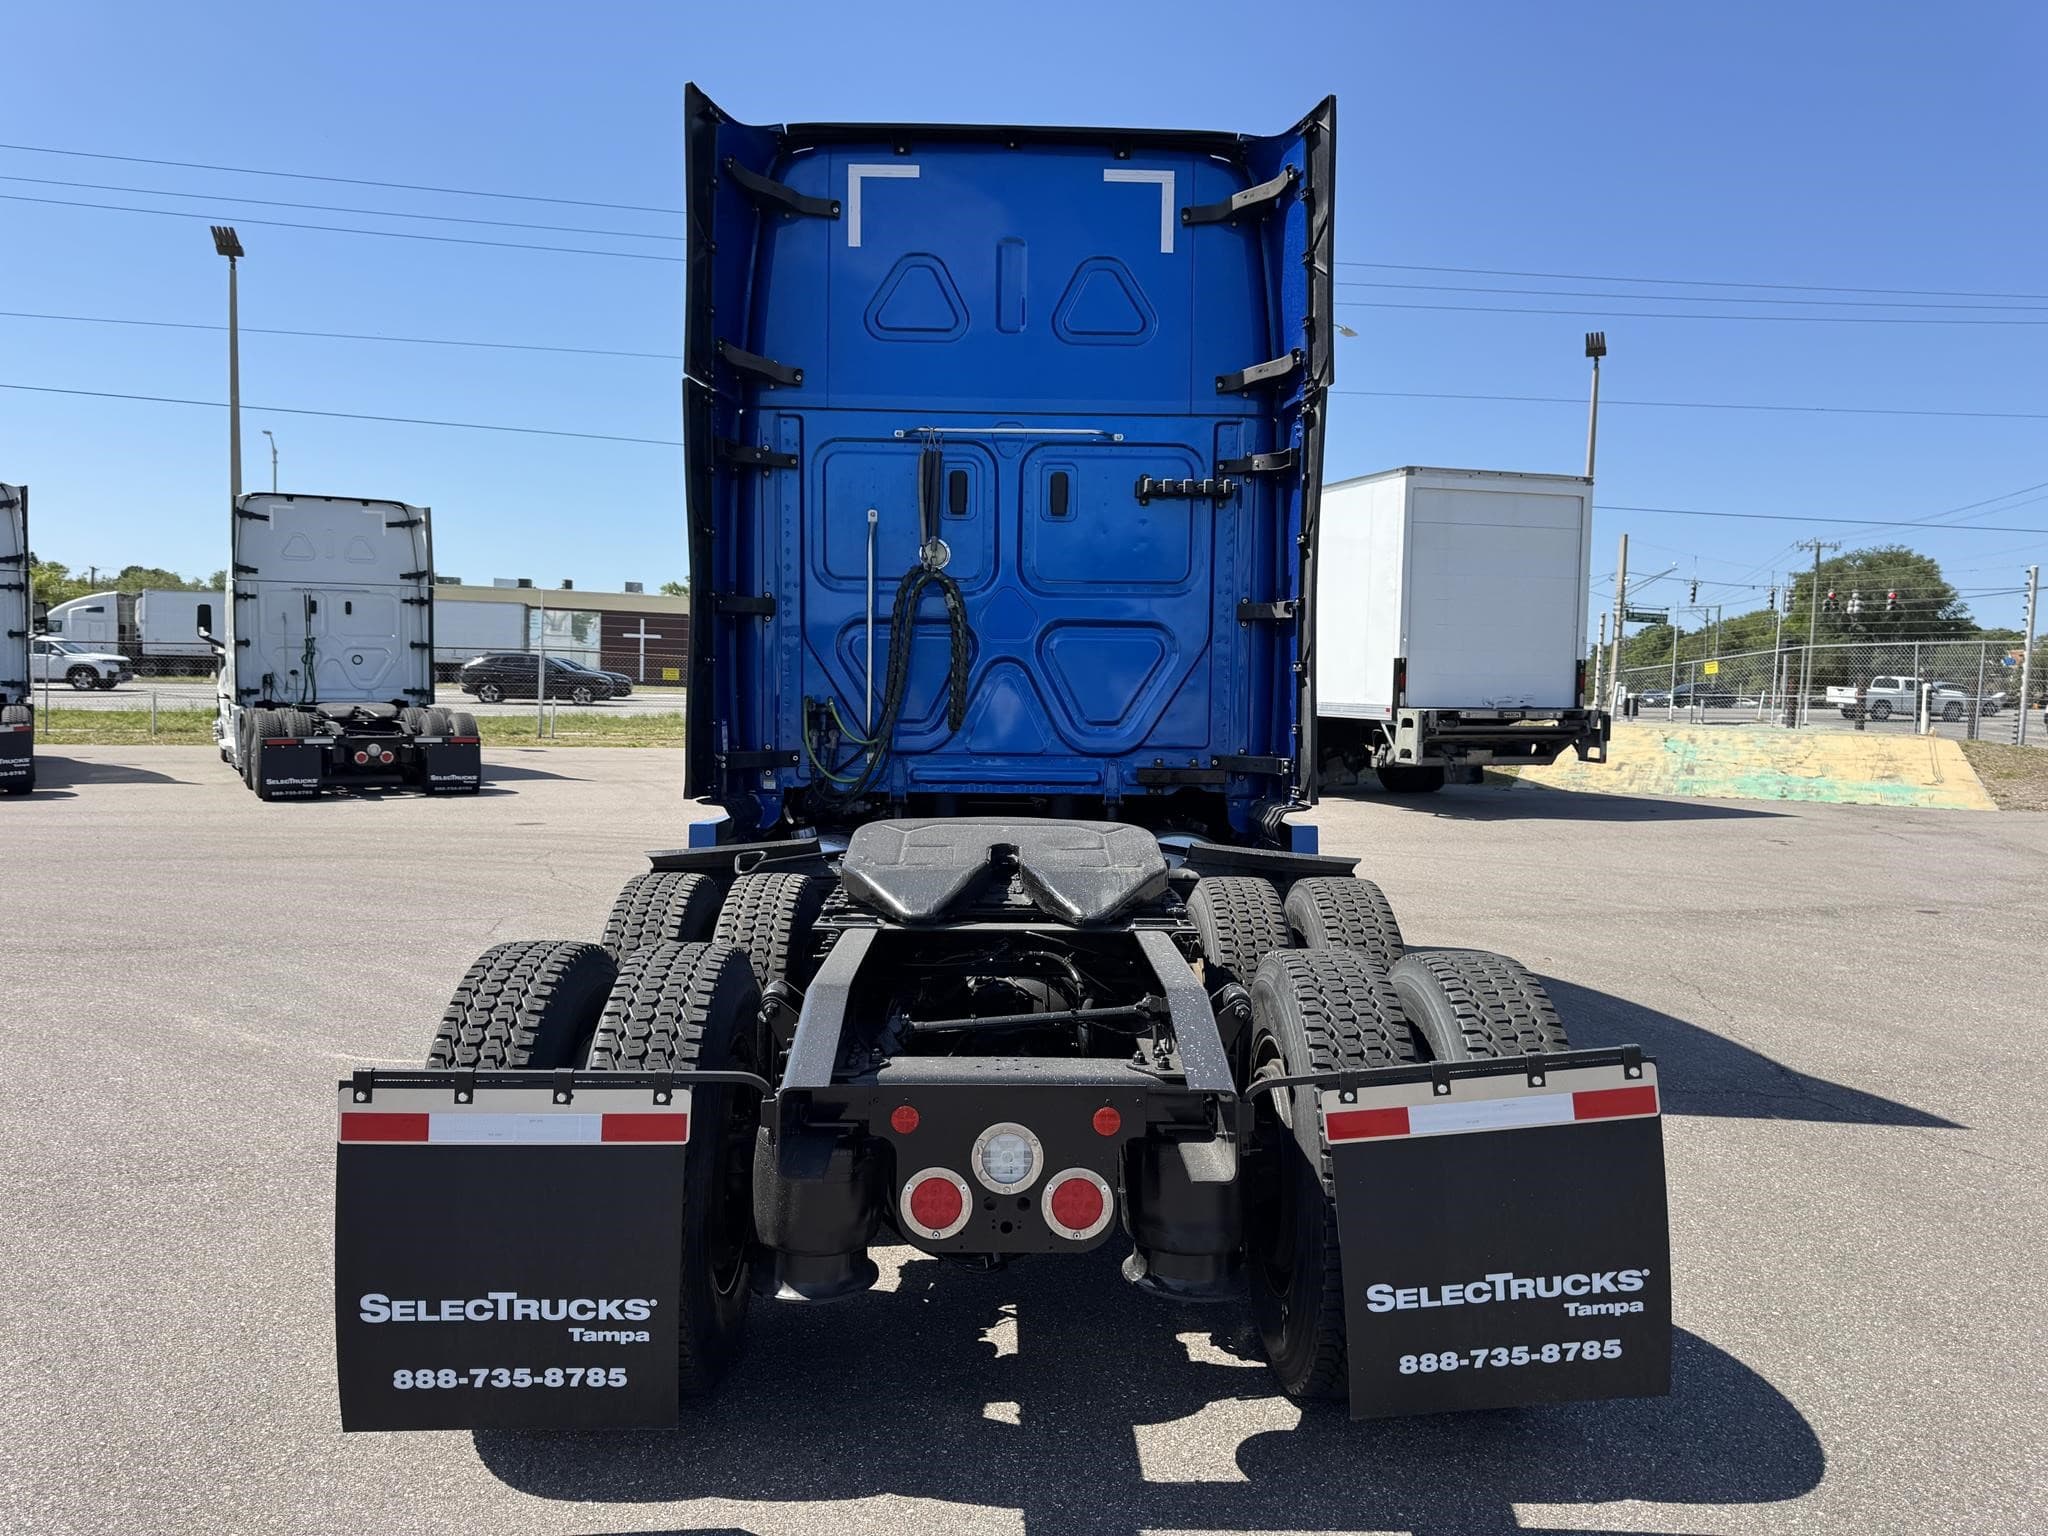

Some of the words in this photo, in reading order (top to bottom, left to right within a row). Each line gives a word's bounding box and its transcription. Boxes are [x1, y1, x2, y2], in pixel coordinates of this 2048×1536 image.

[1366, 1268, 1650, 1313] SELECTRUCKS
[359, 1291, 657, 1323] SELECTRUCKS
[1564, 1300, 1644, 1317] Tampa
[568, 1327, 650, 1345] Tampa
[1399, 1338, 1623, 1374] 888-735-8785
[393, 1367, 628, 1389] 888-735-8785
